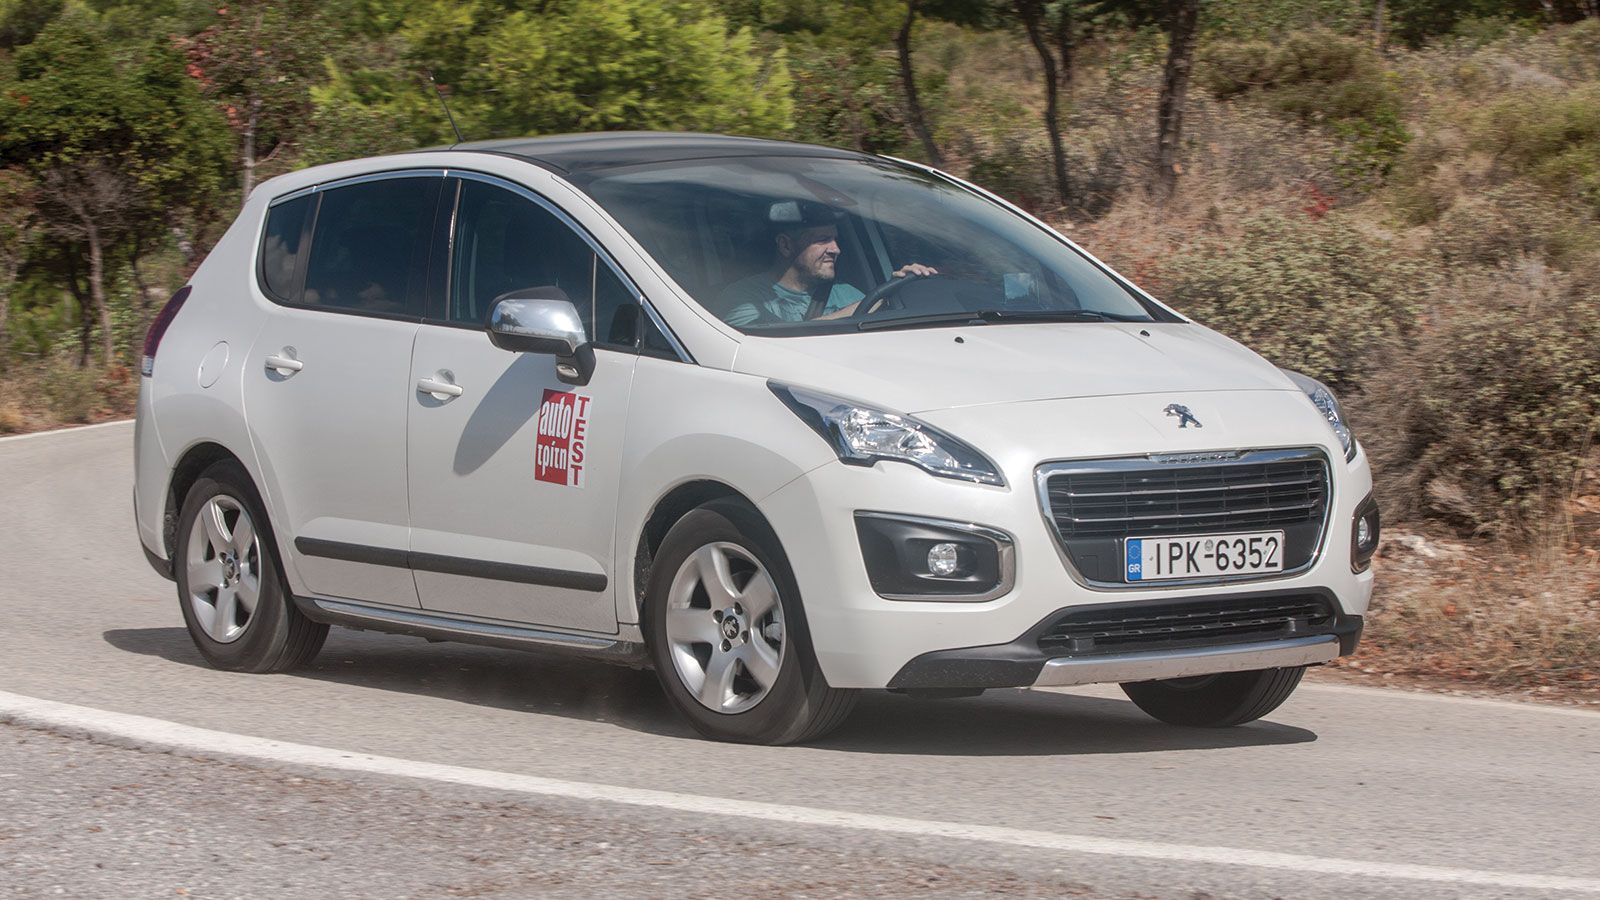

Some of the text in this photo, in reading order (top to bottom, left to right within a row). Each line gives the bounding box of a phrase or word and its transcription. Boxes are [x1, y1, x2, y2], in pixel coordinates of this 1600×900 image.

[539, 396, 572, 440] auto
[570, 396, 590, 485] TEST
[1128, 563, 1141, 574] GR
[1156, 536, 1279, 575] IPK-6352
